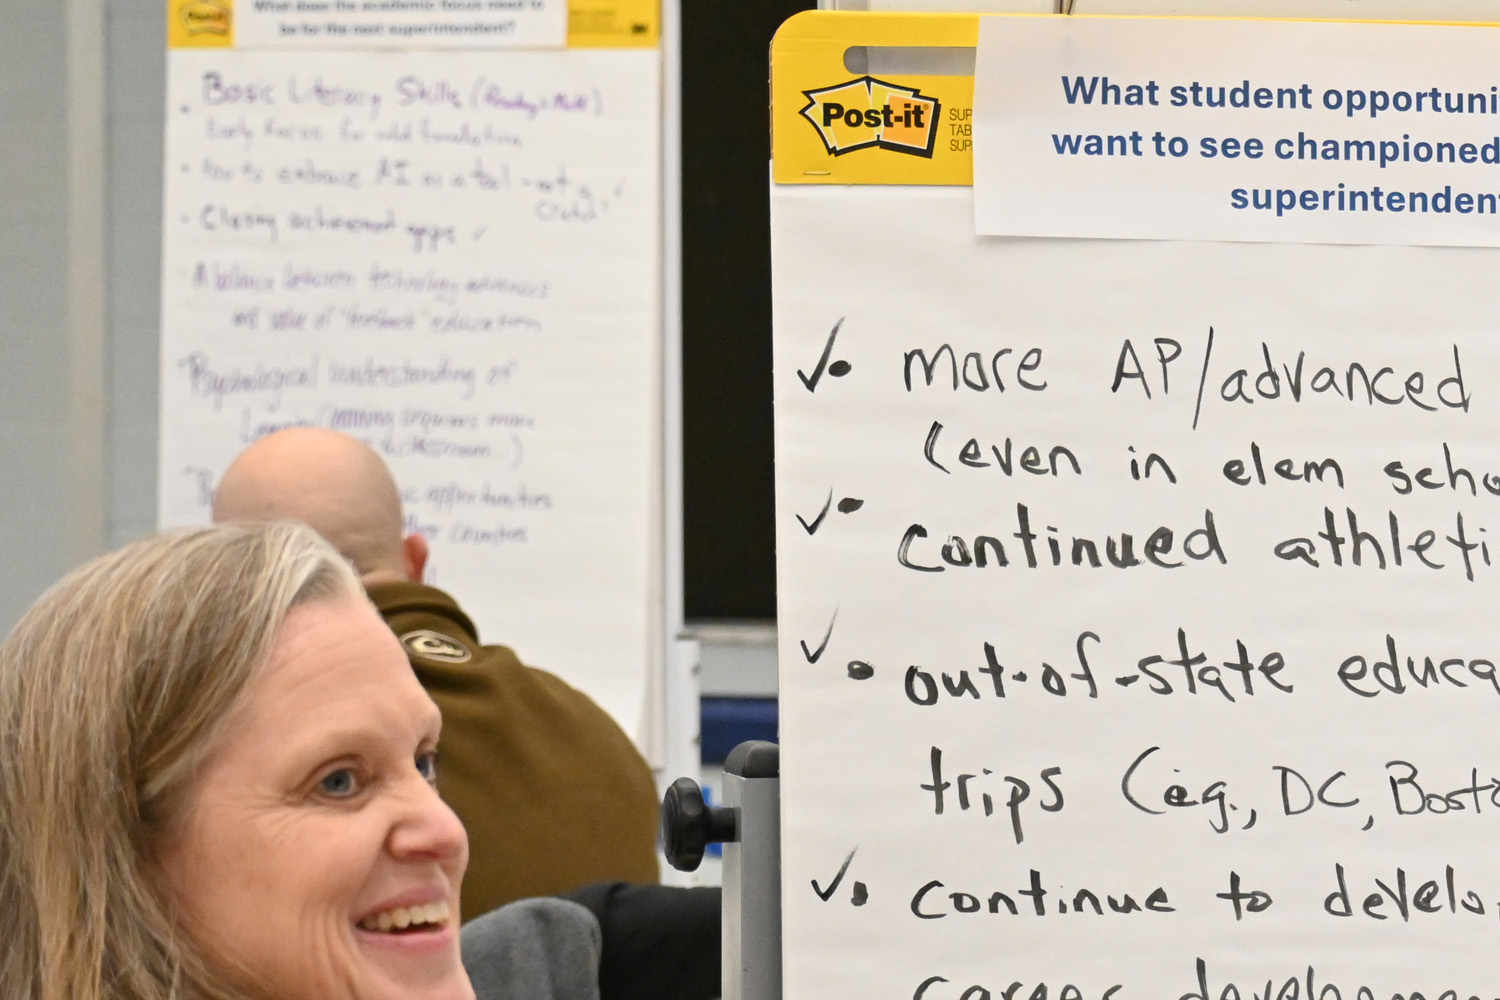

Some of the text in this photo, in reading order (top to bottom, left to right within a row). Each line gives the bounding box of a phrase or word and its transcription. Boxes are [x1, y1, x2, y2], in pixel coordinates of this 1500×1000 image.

[1060, 75, 1160, 107] What
[1169, 79, 1313, 110] student
[1051, 130, 1143, 157] want
[1151, 131, 1189, 158] to
[1199, 136, 1264, 160] see
[1274, 131, 1500, 169] championed
[1110, 325, 1472, 431] AP/advanced
[923, 420, 1082, 477] (even
[1127, 445, 1178, 485] in
[1222, 440, 1345, 490] elem
[920, 745, 1065, 845] trips
[1215, 870, 1274, 922] to
